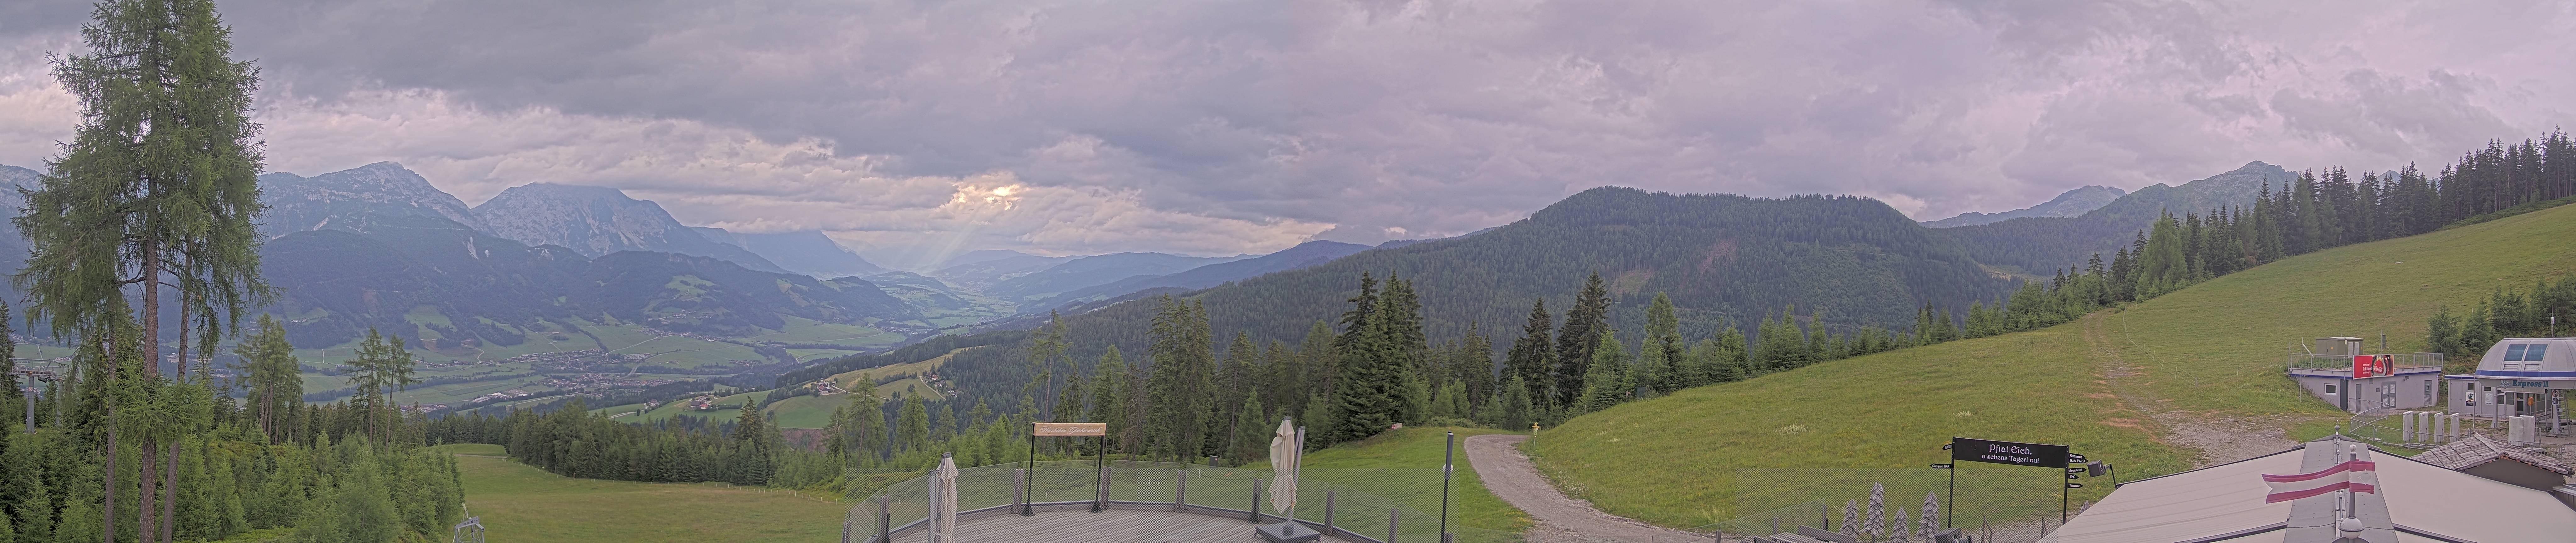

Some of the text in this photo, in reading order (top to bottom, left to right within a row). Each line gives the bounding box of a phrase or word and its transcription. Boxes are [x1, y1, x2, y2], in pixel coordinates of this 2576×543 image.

[2512, 380, 2542, 388] Express
[1989, 444, 2032, 455] Pfiat Eich,
